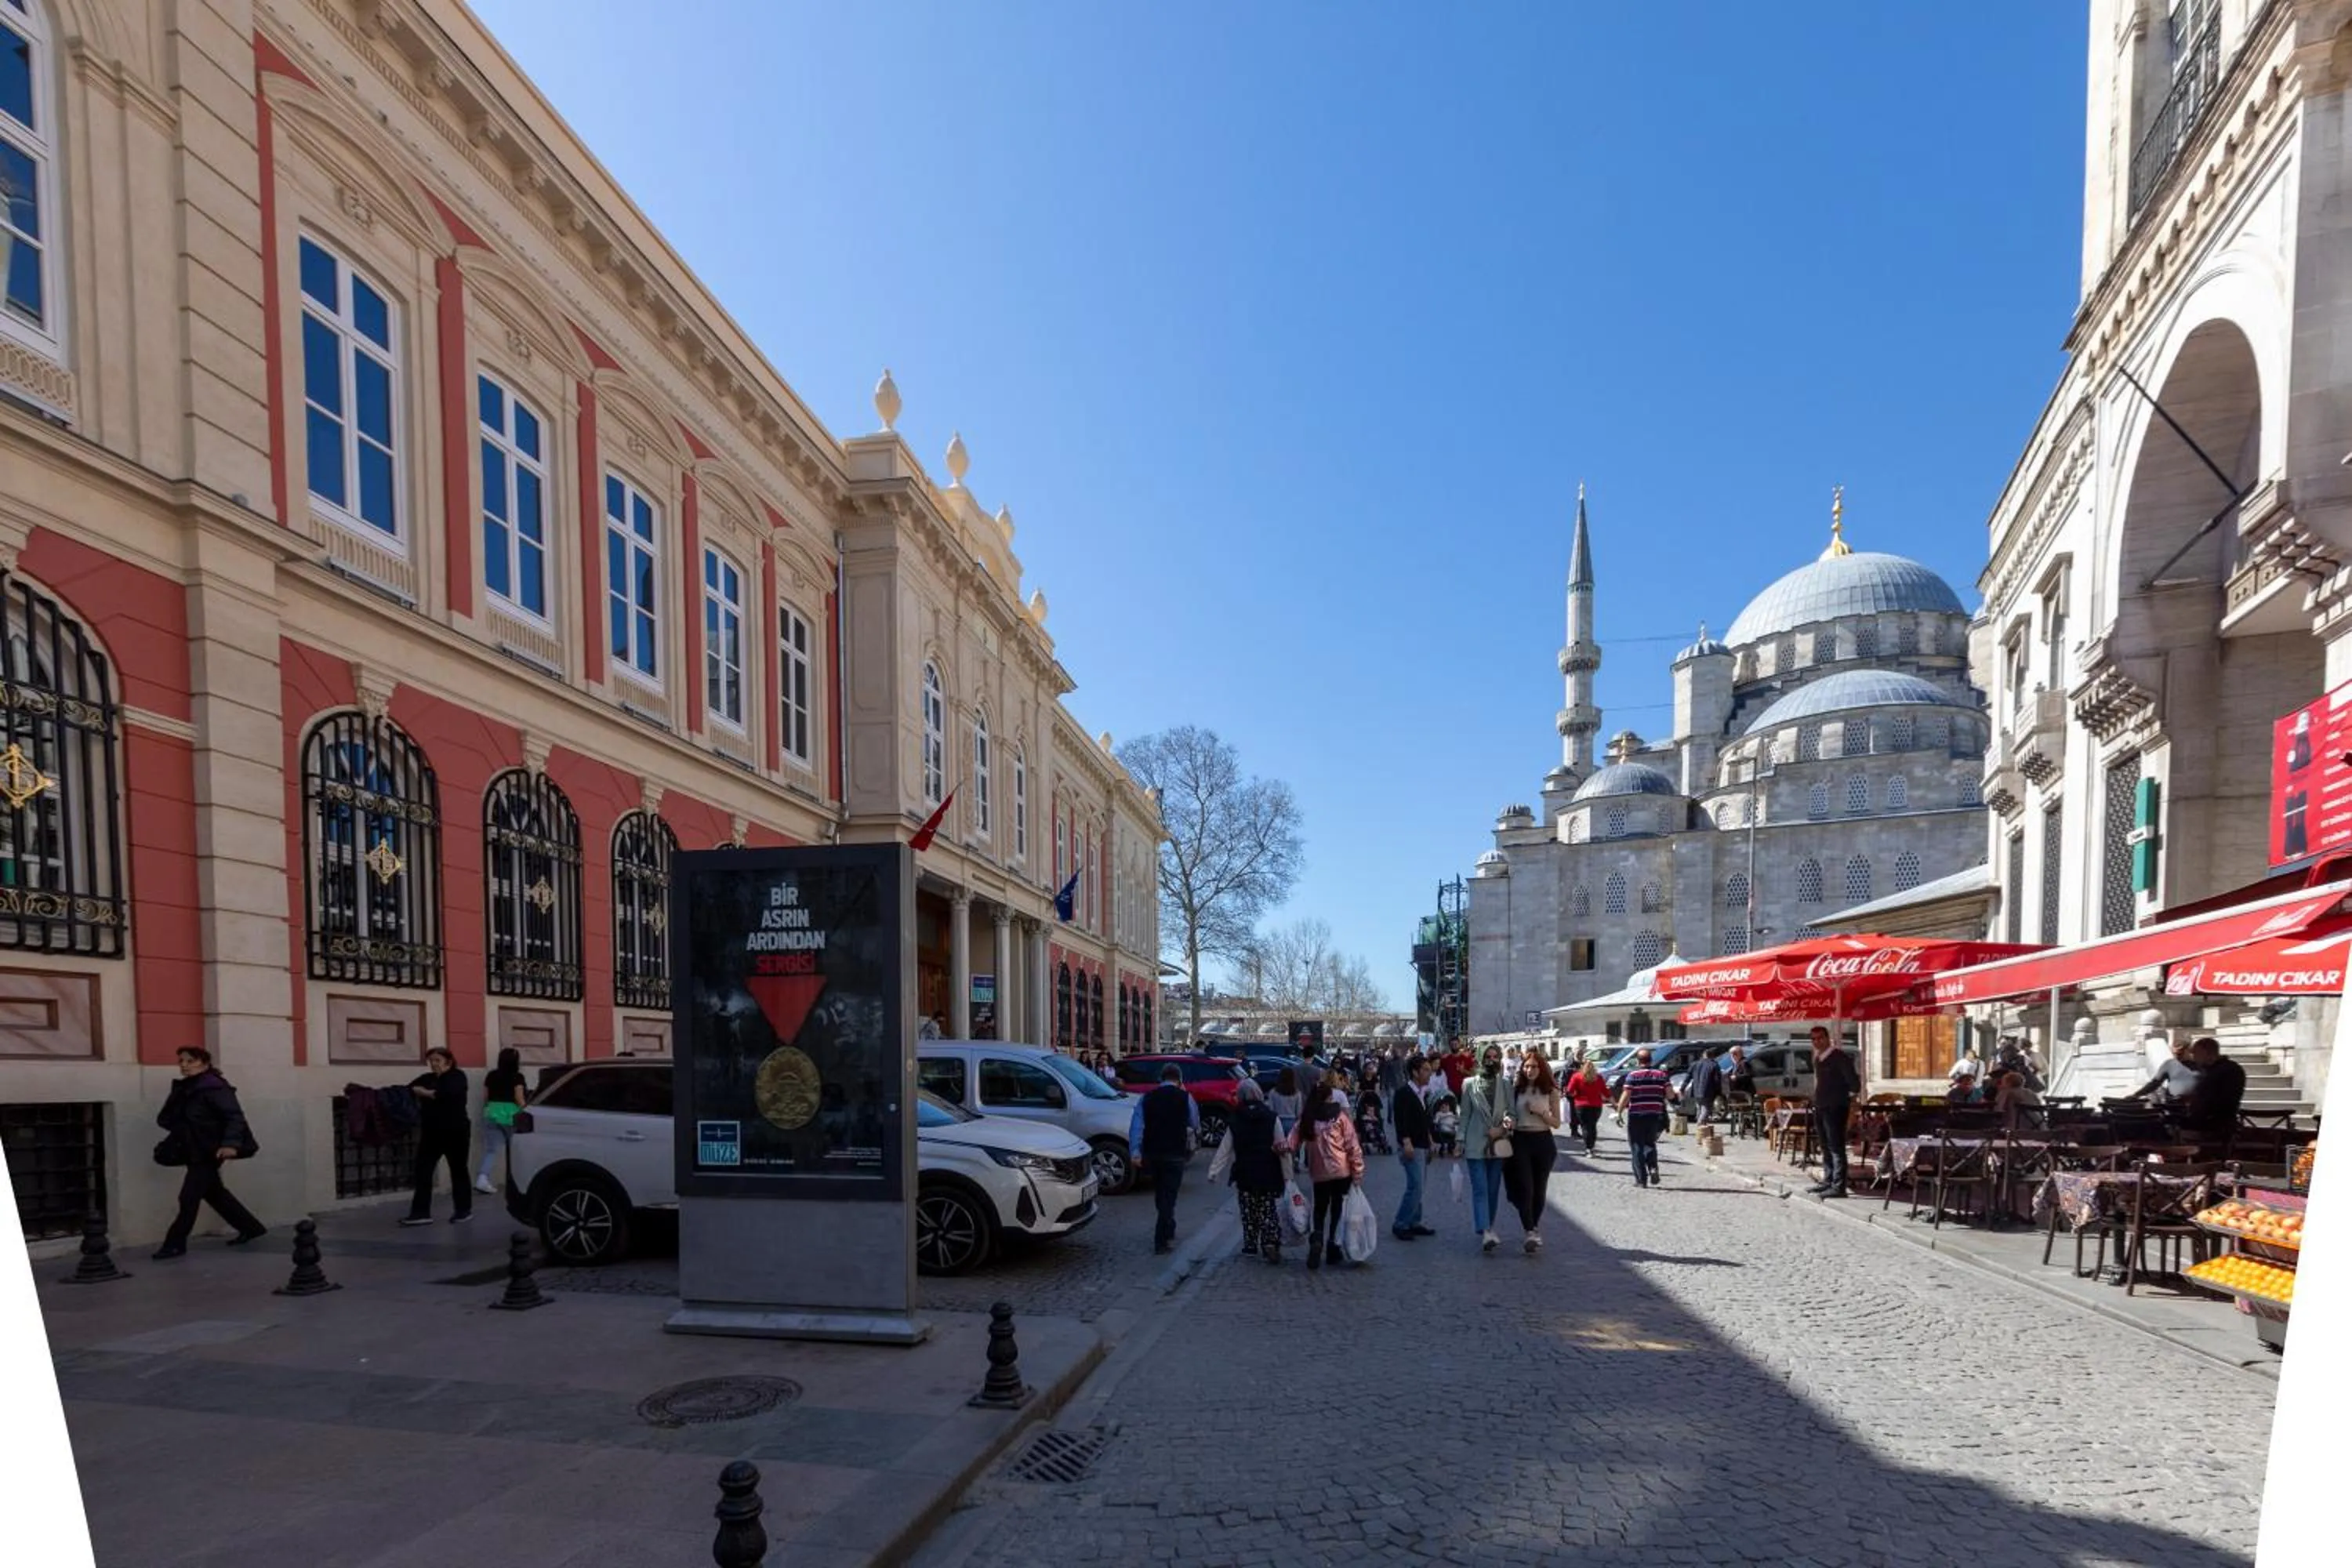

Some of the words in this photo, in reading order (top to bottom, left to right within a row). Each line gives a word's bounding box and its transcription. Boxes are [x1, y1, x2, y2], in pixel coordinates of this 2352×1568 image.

[771, 882, 798, 906] BİR
[761, 909, 809, 927] ASRIN
[746, 931, 826, 950] ARDINDAN
[1806, 947, 1925, 979] Coca-Cola
[1671, 974, 1707, 988] TADINI
[2212, 971, 2275, 985] TADINI
[2278, 970, 2340, 987] ÇIKAR
